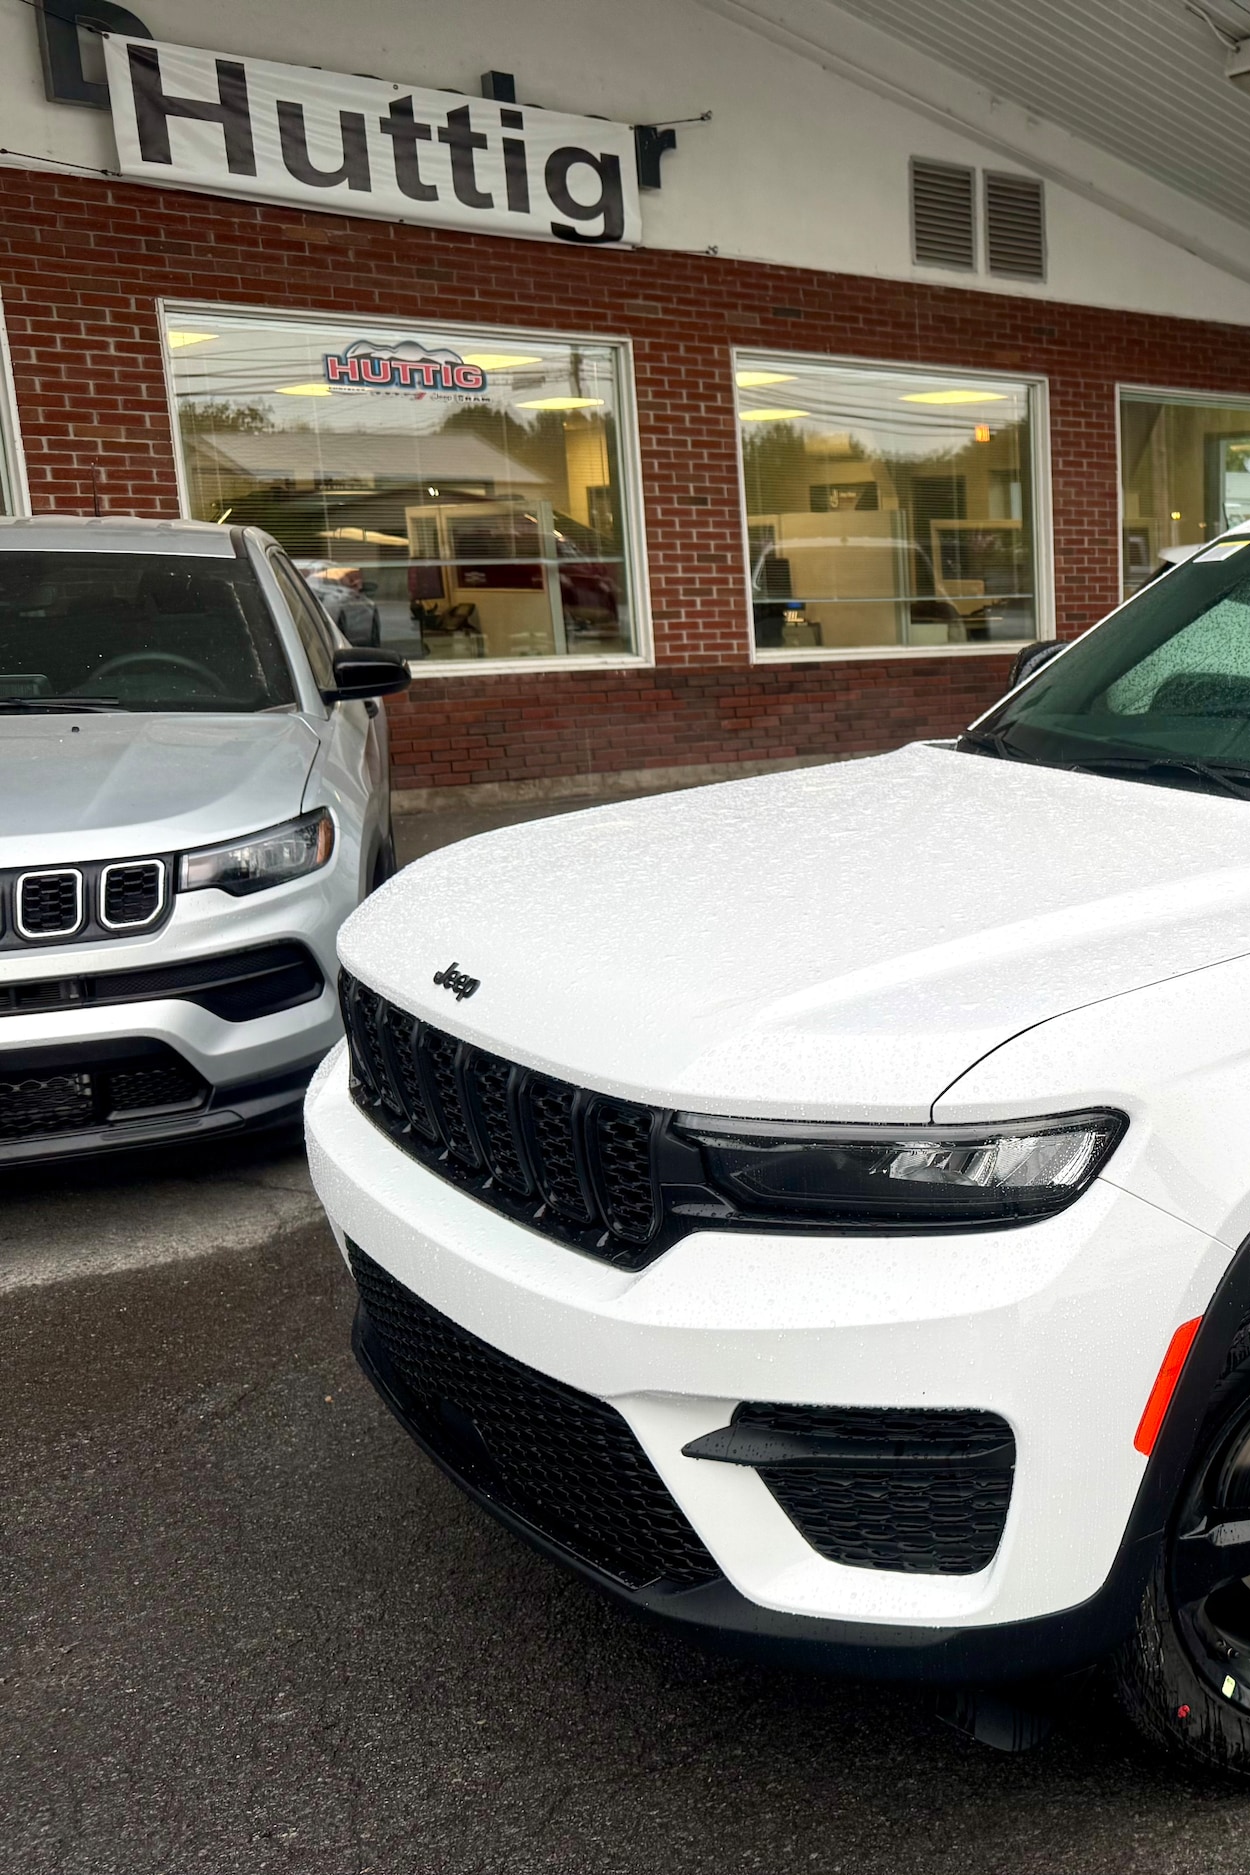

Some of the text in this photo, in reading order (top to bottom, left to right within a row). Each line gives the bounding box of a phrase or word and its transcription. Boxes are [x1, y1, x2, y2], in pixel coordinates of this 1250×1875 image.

[126, 43, 625, 244] Huttig
[327, 356, 484, 389] HUTTIG
[433, 961, 481, 1002] Jeep
